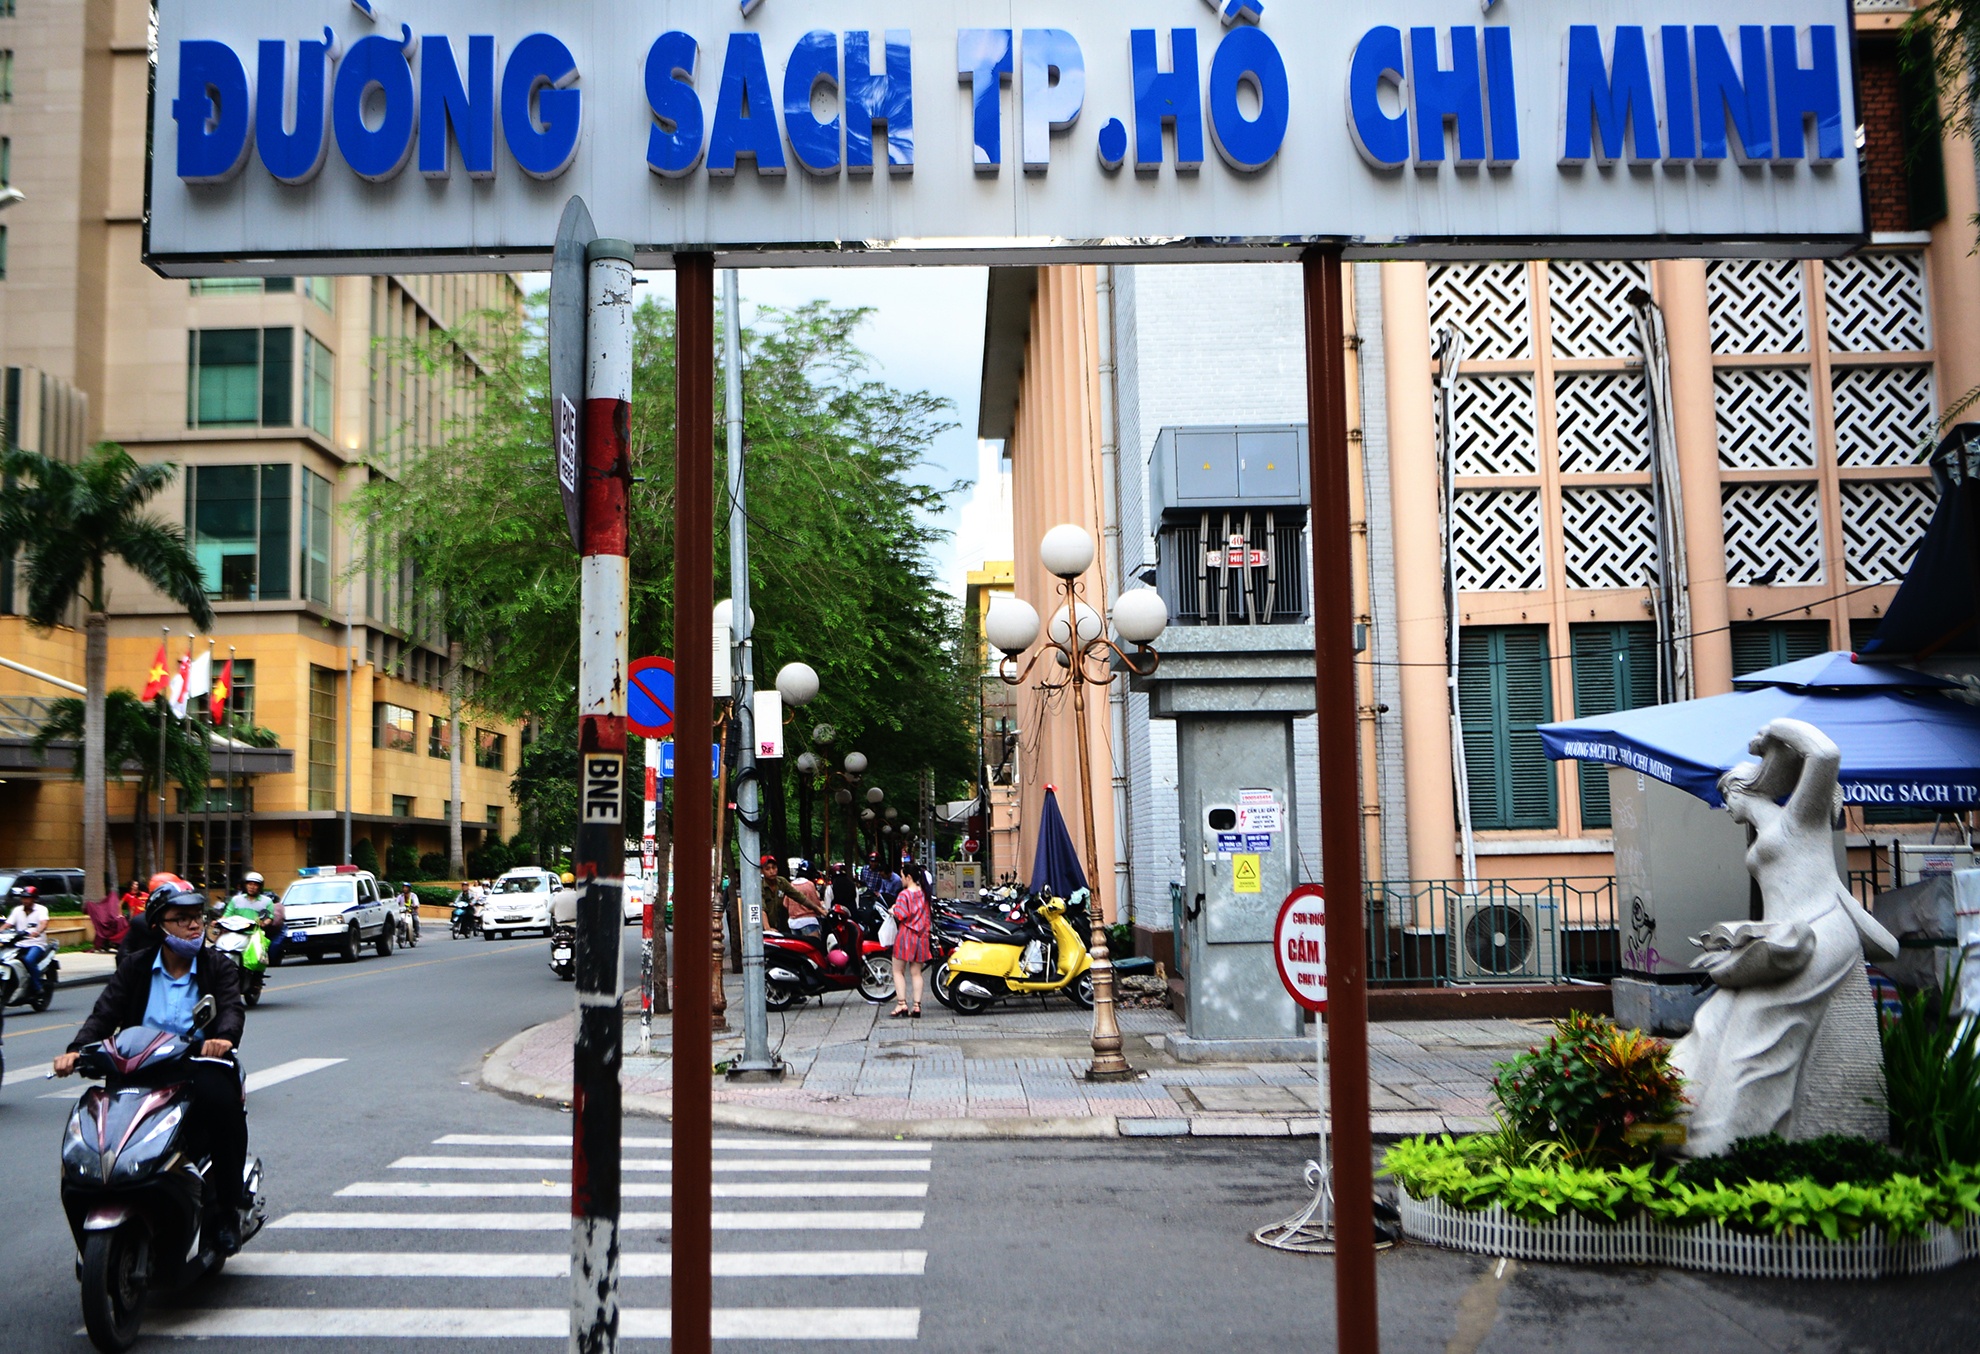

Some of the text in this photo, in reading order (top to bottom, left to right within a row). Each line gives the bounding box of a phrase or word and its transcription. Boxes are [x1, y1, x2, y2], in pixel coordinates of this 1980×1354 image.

[1557, 25, 1846, 168] MINH
[563, 400, 575, 446] BNE
[561, 458, 573, 487] HERE
[1648, 758, 1673, 783] MINH
[586, 759, 620, 818] BNE
[1842, 780, 1895, 802] ƯỜNG
[1898, 782, 1950, 802] SÁCH
[645, 840, 654, 854] BNE
[750, 906, 759, 922] BNE
[1293, 912, 1307, 926] CON
[1287, 932, 1320, 964] CẤM
